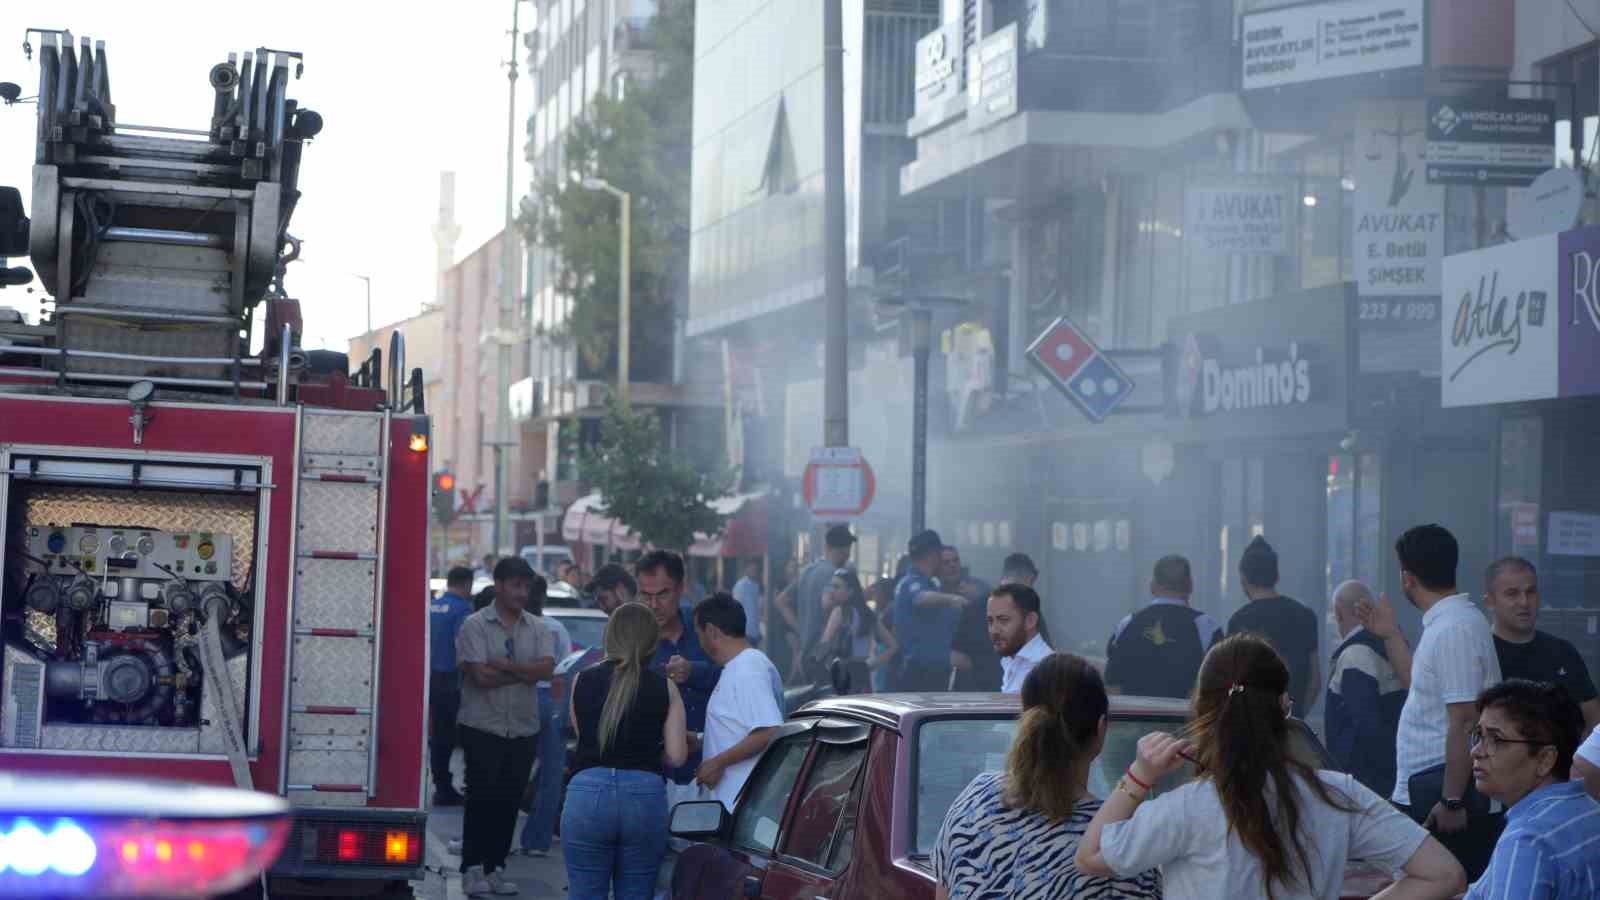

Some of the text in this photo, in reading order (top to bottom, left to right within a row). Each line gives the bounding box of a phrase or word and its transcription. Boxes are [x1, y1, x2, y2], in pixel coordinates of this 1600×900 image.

[1357, 212, 1440, 233] AVUKAT
[1367, 243, 1381, 258] E.
[1572, 250, 1600, 333] R
[1203, 340, 1311, 412] Domino's
